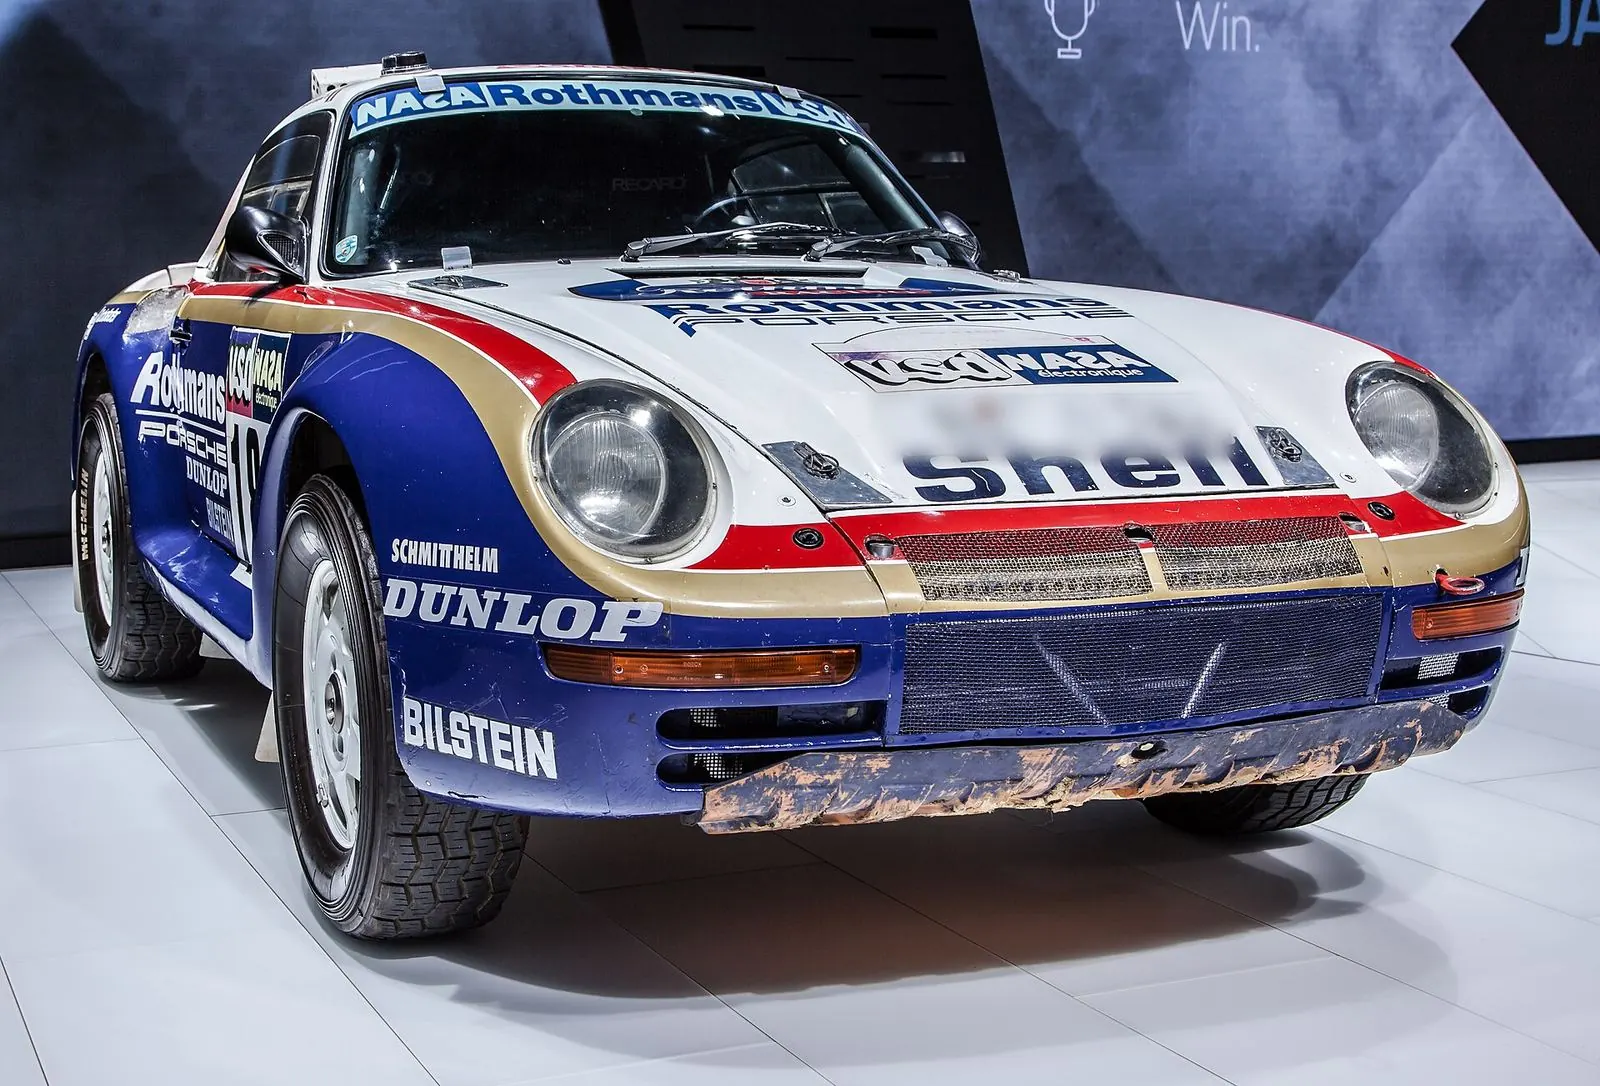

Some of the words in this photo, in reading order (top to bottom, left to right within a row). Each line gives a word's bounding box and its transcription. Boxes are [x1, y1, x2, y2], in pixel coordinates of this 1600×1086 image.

[1176, 0, 1260, 52] Win.
[486, 83, 763, 113] Rothmans
[641, 297, 1111, 320] Rothmans
[677, 308, 1136, 337] PORSCHE
[130, 350, 226, 425] Rothmans
[1037, 367, 1145, 379] électronique
[138, 420, 228, 468] PORSCHE
[185, 455, 228, 498] DUNLOP
[80, 467, 90, 561] MICHELIN
[391, 538, 498, 573] SCHMITTHELM
[384, 577, 664, 642] DUNLOP
[403, 697, 557, 780] BILSTEIN
